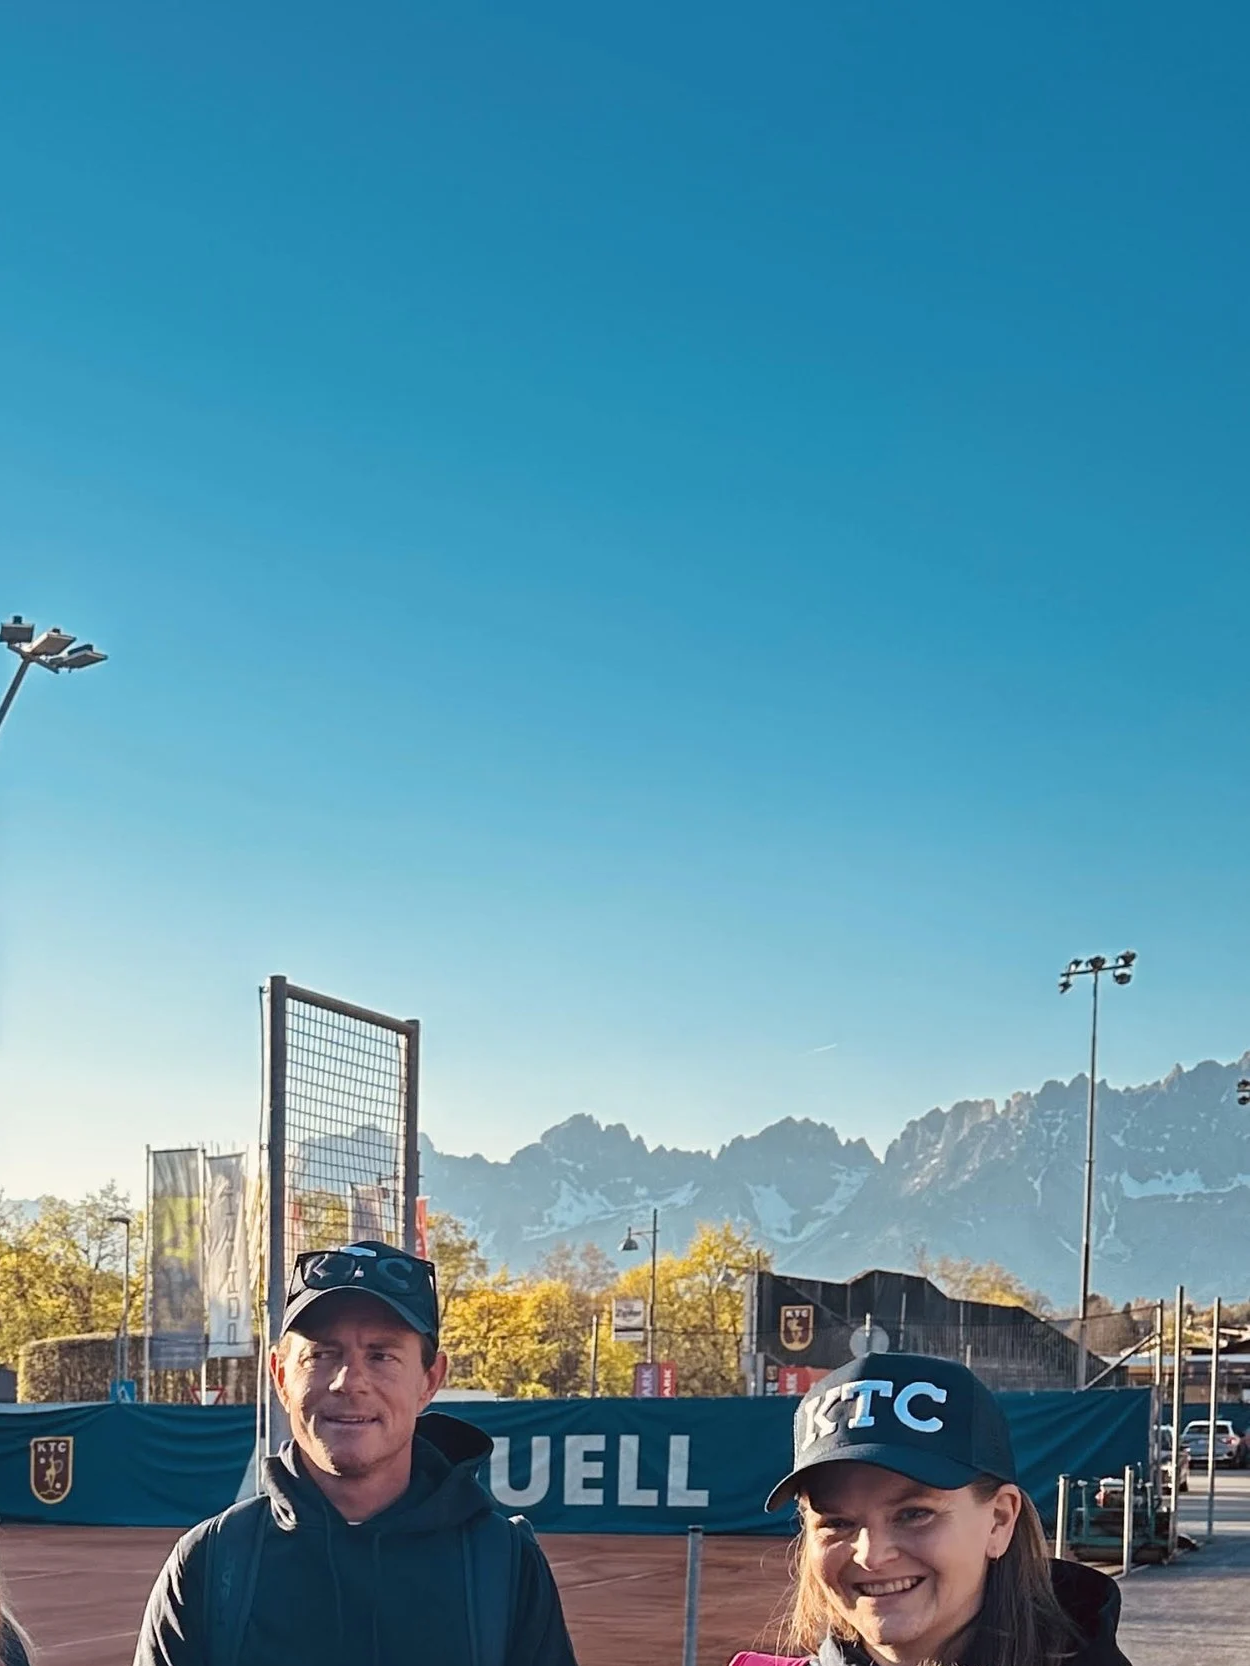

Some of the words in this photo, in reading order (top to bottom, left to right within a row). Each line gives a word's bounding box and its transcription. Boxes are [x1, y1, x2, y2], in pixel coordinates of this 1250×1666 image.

[786, 1309, 809, 1318] KTC
[801, 1379, 948, 1451] KTC
[37, 1441, 67, 1453] KTC
